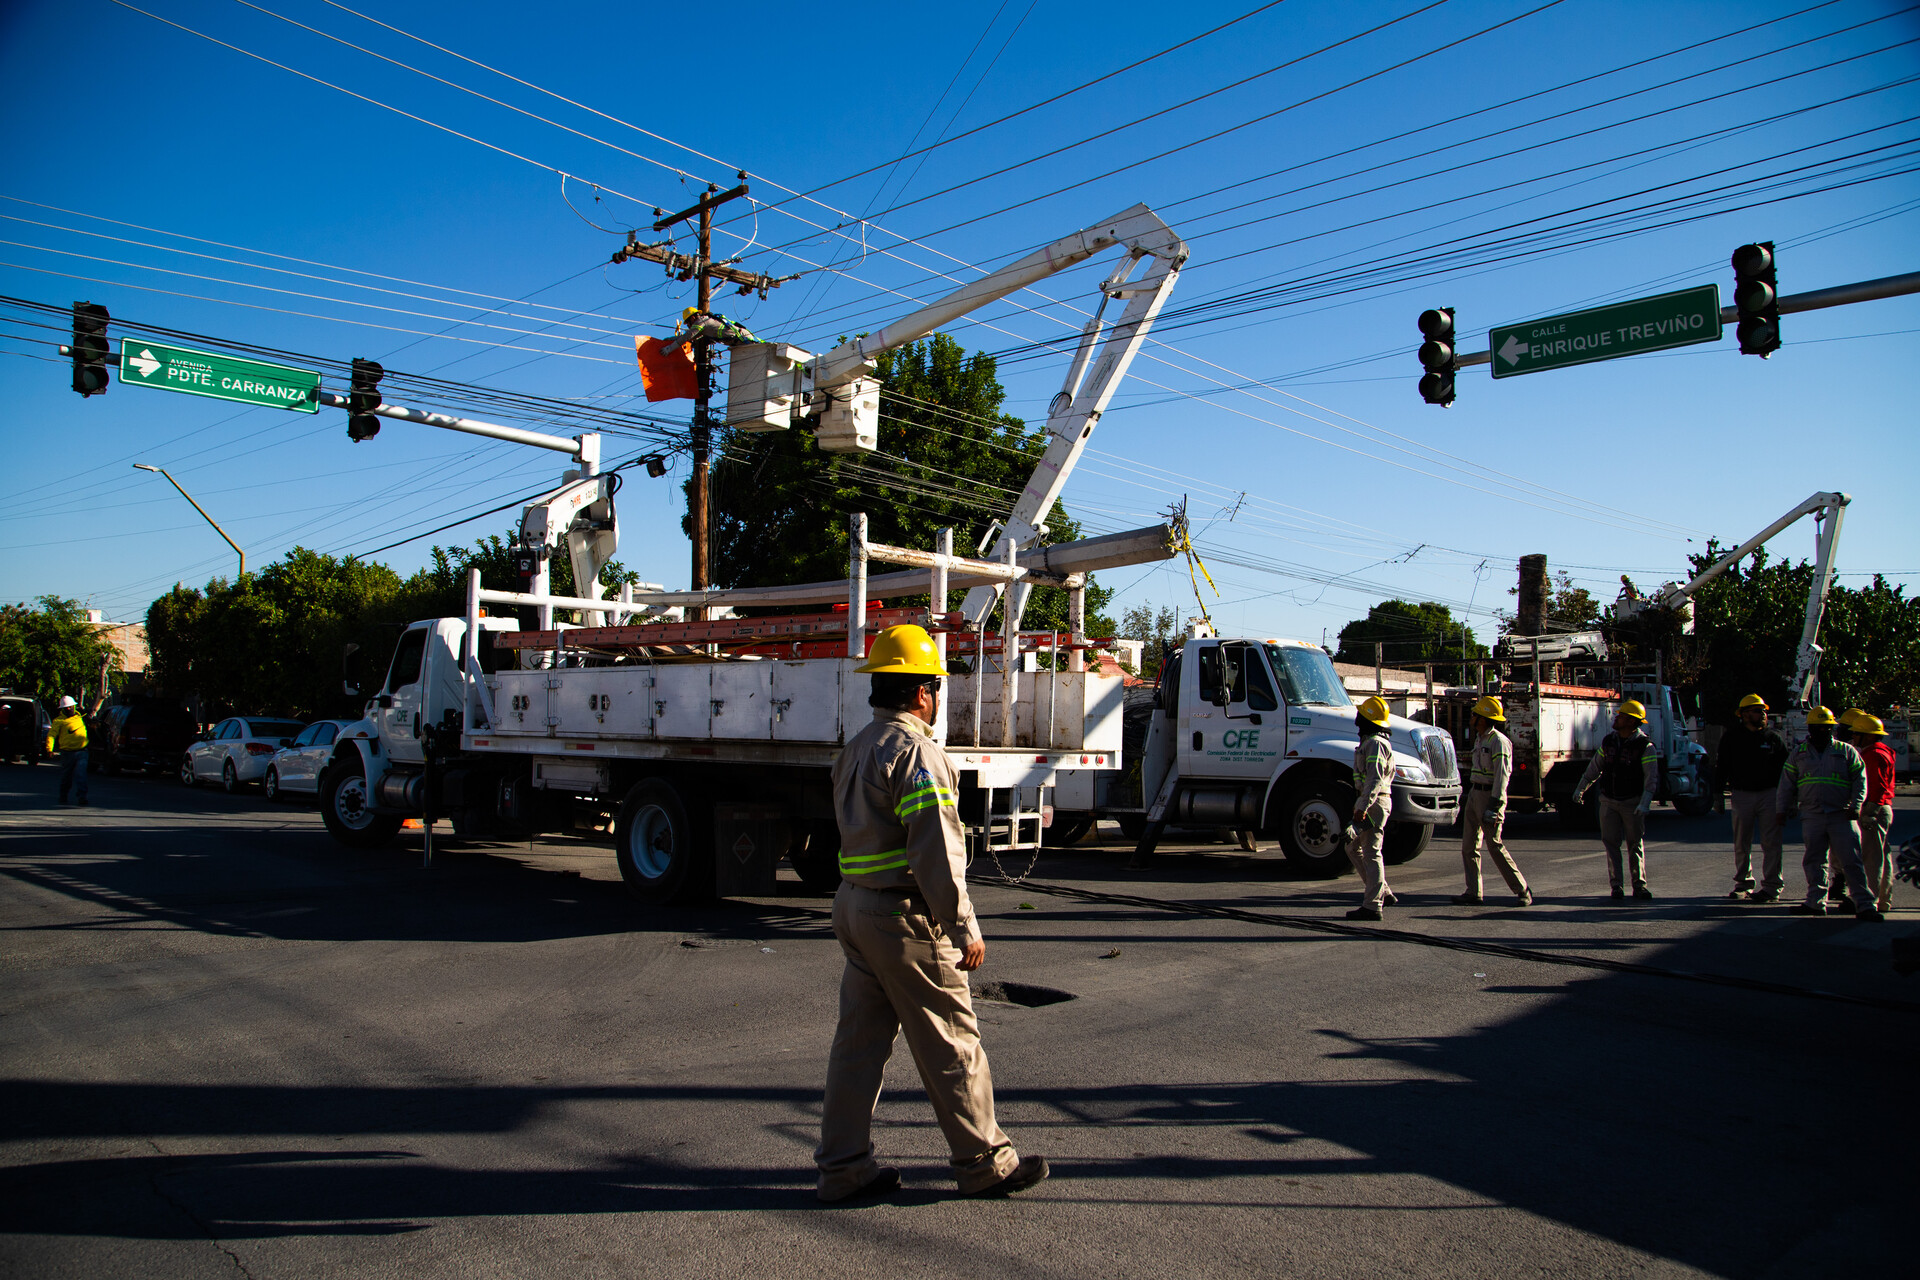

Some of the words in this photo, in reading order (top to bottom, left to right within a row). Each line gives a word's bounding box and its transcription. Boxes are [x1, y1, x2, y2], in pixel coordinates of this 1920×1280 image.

[1530, 331, 1612, 359] ENRIQUE
[1617, 313, 1704, 343] TREVIÑO
[1532, 324, 1566, 338] CALLE
[169, 358, 213, 373] AVENIDA
[168, 367, 215, 387] PDTE.
[221, 377, 307, 402] CARRANZA
[397, 710, 408, 722] CFE
[1223, 730, 1260, 749] CFE
